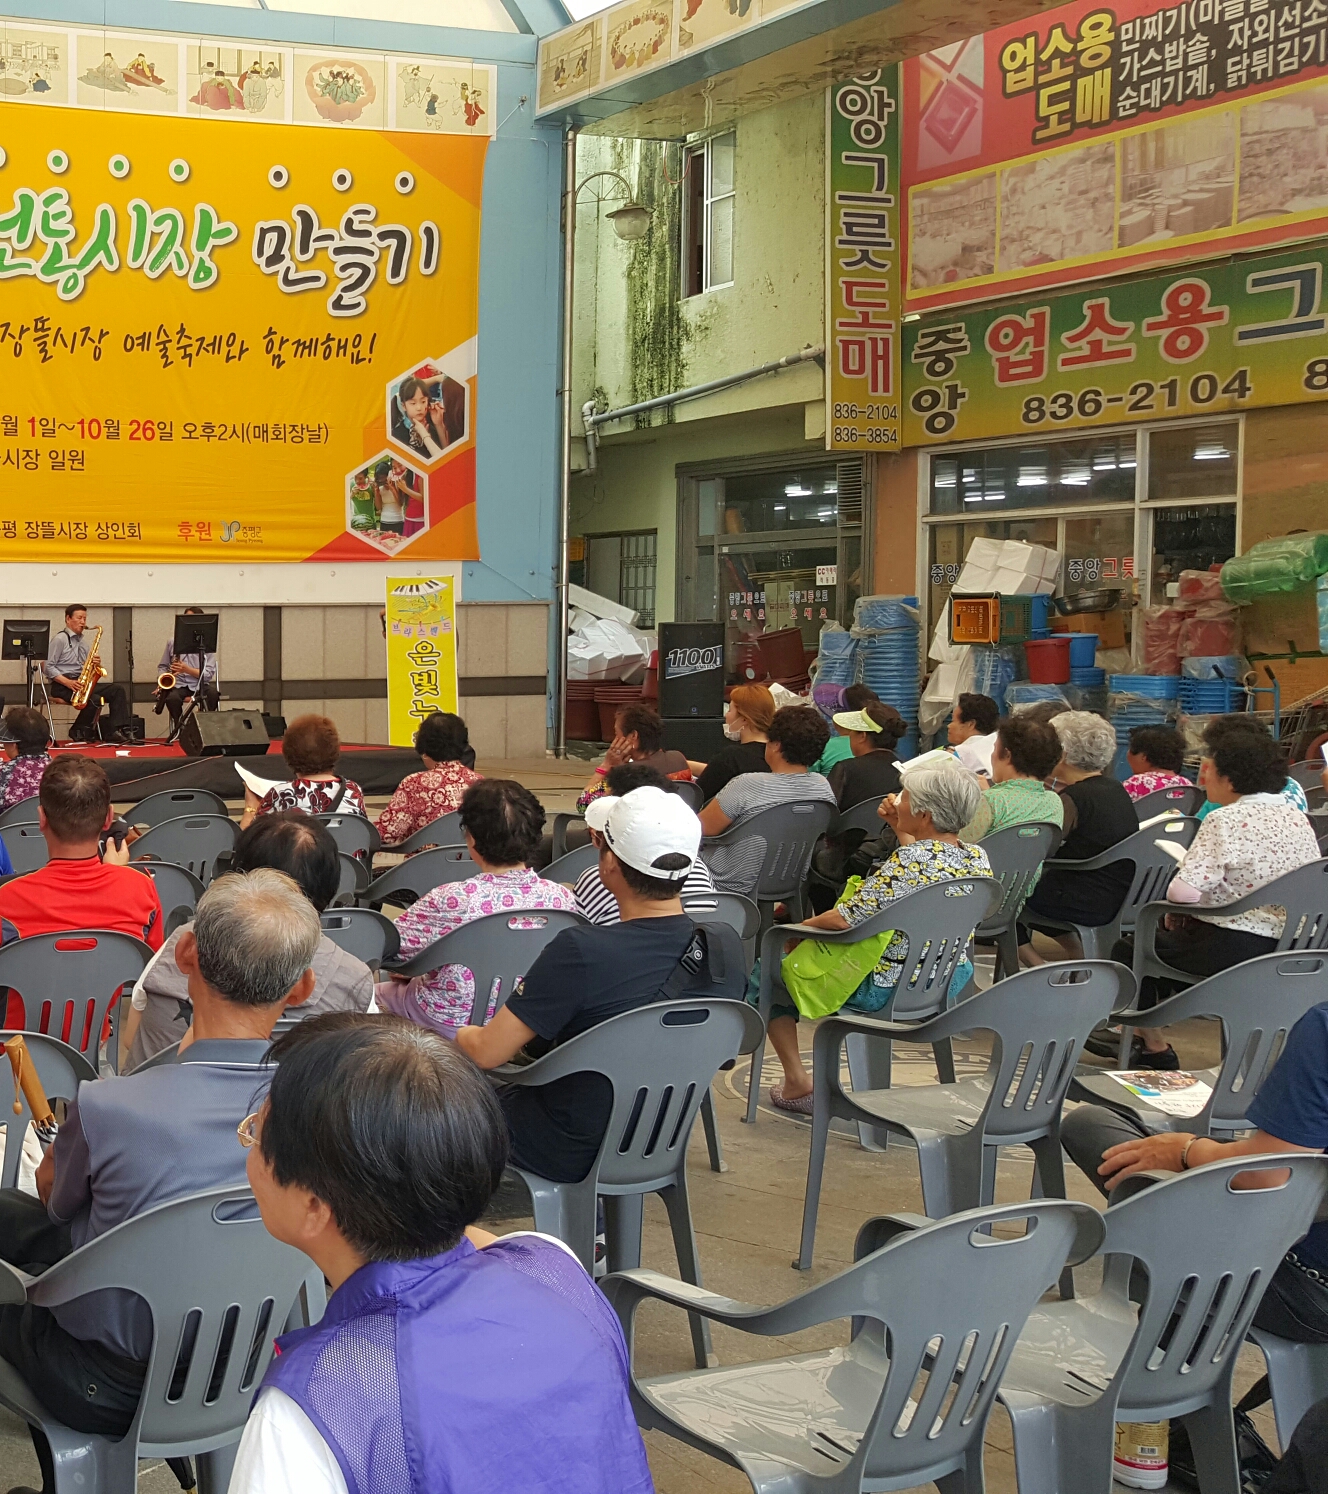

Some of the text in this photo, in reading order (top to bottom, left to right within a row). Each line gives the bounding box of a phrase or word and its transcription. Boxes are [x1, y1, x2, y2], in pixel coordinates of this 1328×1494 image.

[1001, 13, 1115, 93] 업소용
[1119, 33, 1218, 82] 가스밥솥,
[1035, 67, 1112, 139] 도매
[1117, 68, 1215, 117] 순대기계,
[836, 68, 895, 394] 앙그릇도매
[254, 205, 438, 314] 만들기
[123, 323, 250, 368] 예술축제와
[912, 322, 970, 434] 중앙
[1021, 367, 1252, 424] 836-2104
[128, 419, 174, 441] 26일
[181, 421, 329, 444] 오후2시(매회장날)
[834, 403, 898, 422] 836-2104
[834, 426, 898, 444] 836-3854
[49, 450, 86, 471] 일원
[24, 520, 88, 541] 장뜰시장
[95, 521, 142, 541] 상인회
[177, 521, 213, 542] 후원
[242, 526, 263, 539] 증평군
[668, 647, 716, 667] 1100
